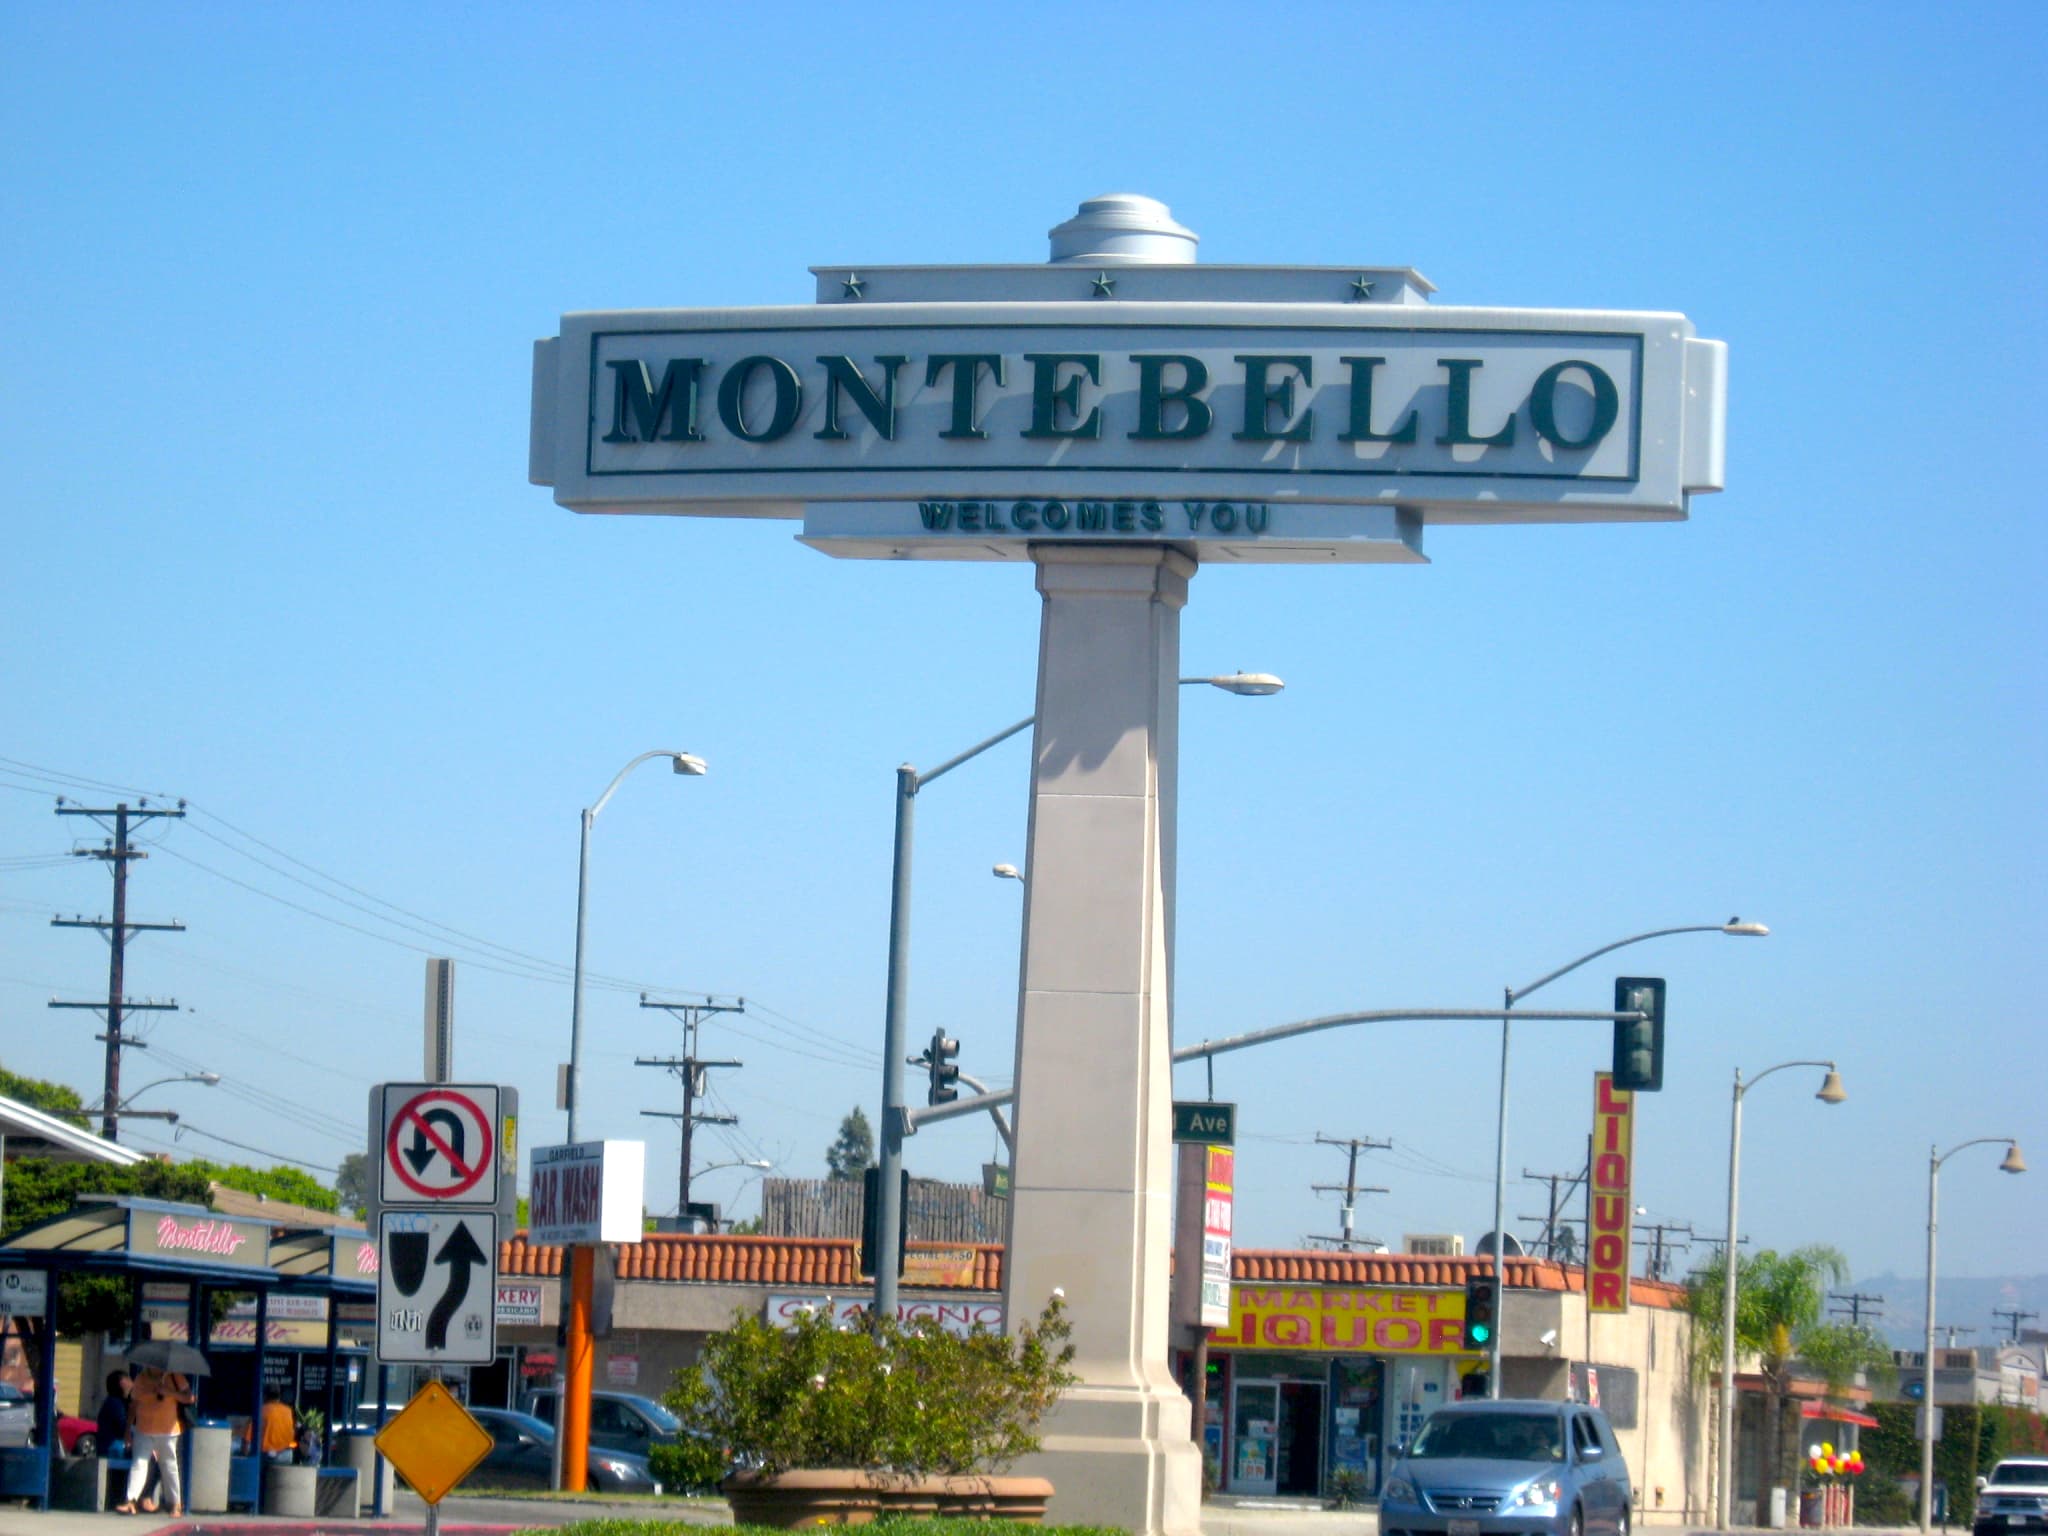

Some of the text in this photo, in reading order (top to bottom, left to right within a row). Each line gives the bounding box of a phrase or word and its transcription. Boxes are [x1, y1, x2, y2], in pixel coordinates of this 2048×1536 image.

[602, 353, 1619, 450] MONTEBELLO
[918, 501, 1271, 533] WELCOMES YOU
[1189, 1112, 1228, 1134] Ave
[549, 1147, 585, 1163] GARFIELD
[531, 1162, 599, 1228] CAR WASH
[1591, 1078, 1628, 1309] LIQUOR
[1239, 1288, 1442, 1314] MARKET
[1208, 1312, 1465, 1351] LIQUOR
